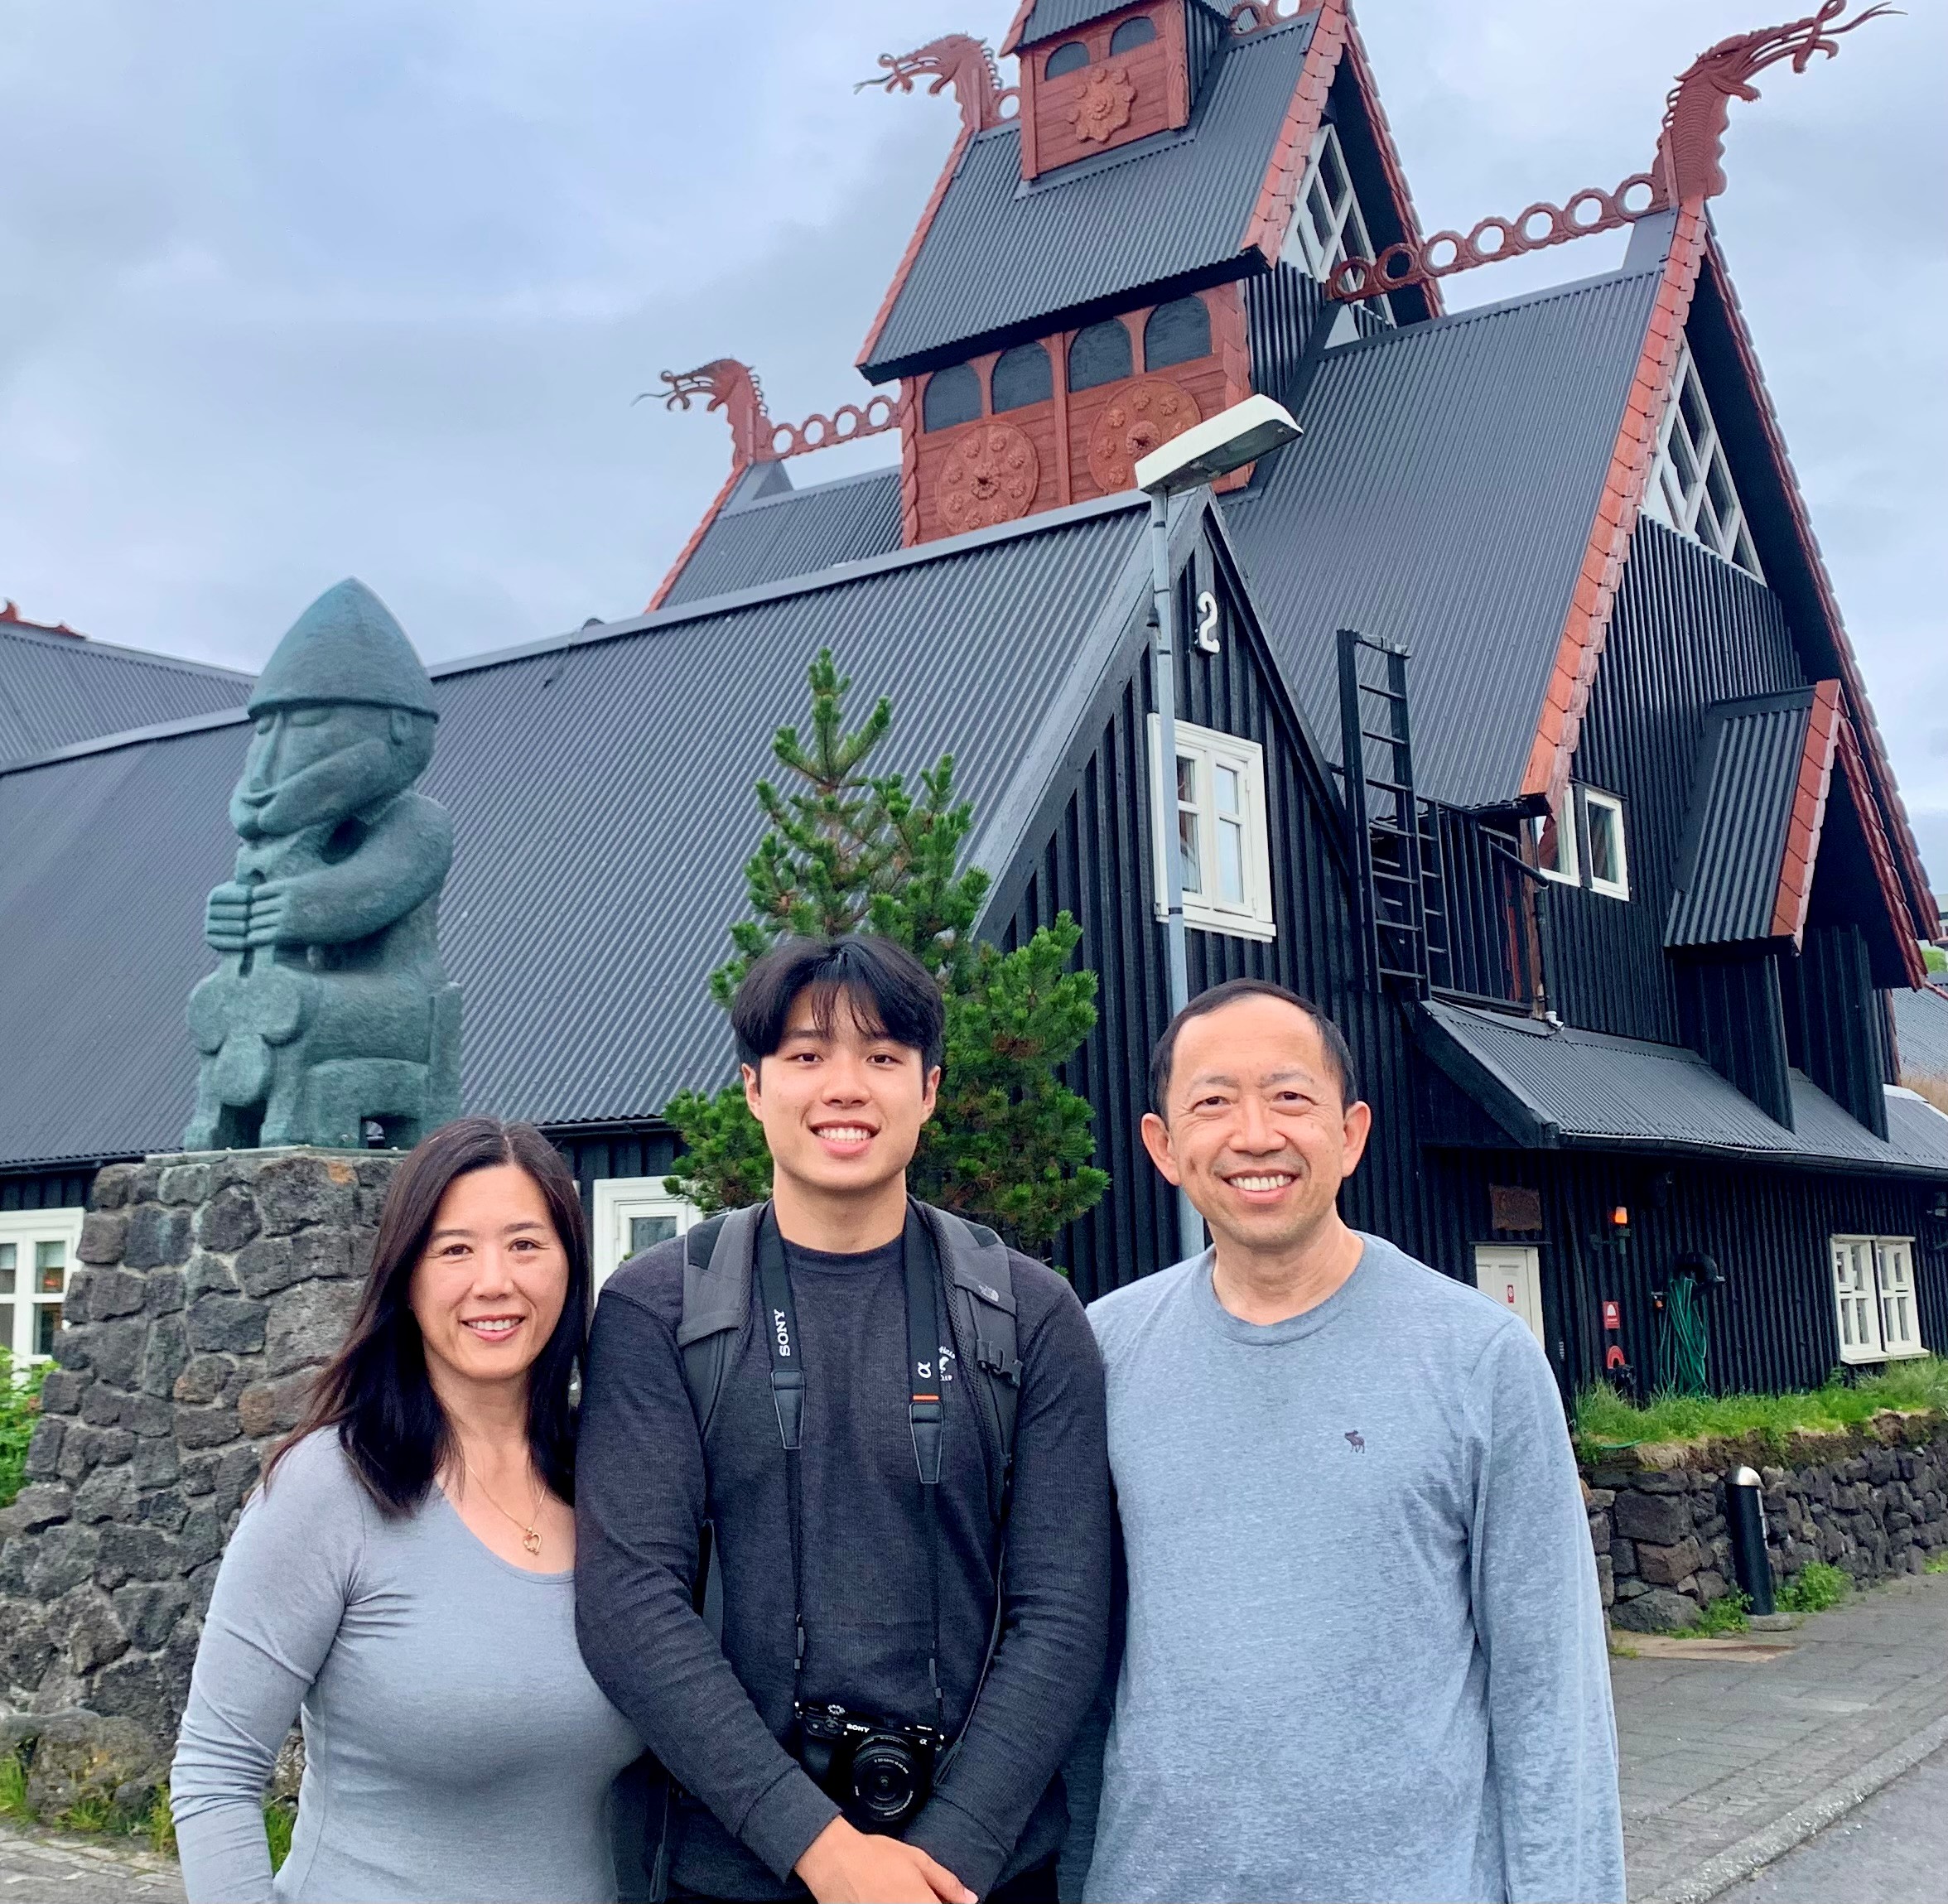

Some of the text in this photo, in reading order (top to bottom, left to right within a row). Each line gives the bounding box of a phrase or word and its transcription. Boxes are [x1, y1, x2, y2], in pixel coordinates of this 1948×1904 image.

[1198, 590, 1220, 653] 2
[774, 1309, 790, 1357] SONY
[846, 1723, 870, 1733] SONY
